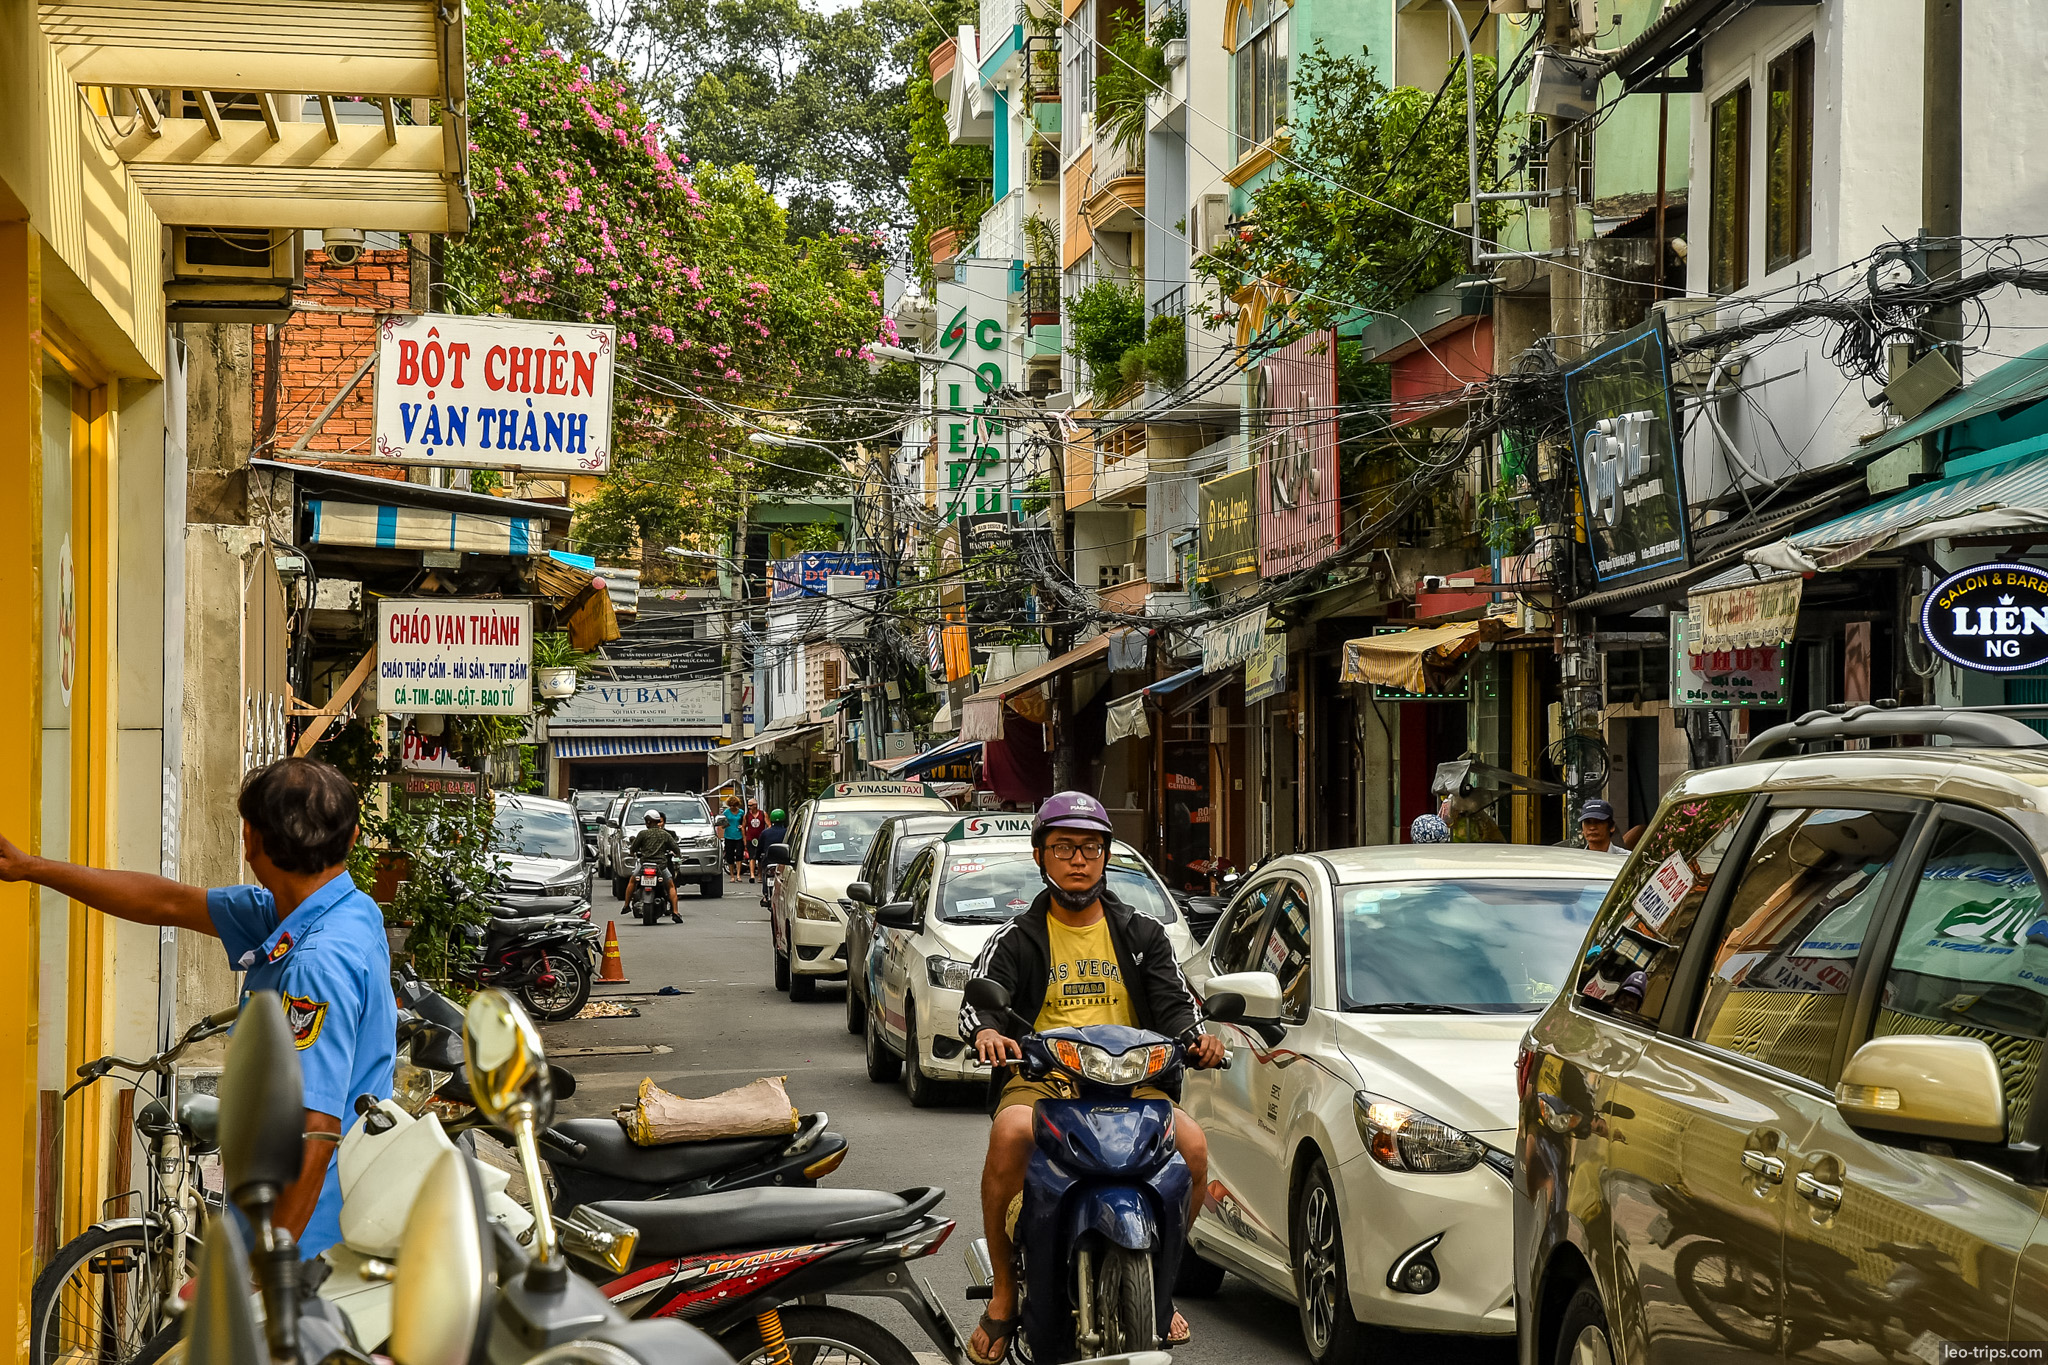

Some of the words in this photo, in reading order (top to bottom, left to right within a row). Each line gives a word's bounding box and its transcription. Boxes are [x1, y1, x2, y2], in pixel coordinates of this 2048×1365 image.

[397, 326, 470, 400] BỘT
[484, 334, 598, 398] CHIÊN
[400, 402, 470, 456] VẠN
[477, 398, 588, 454] THÀNH
[1939, 575, 1988, 610] SALON
[1992, 572, 2002, 586] &
[2006, 572, 2048, 597] BARB
[390, 608, 431, 645] CHÁO
[435, 614, 465, 651] VẠN
[470, 608, 520, 646] THÀNH
[1986, 640, 2020, 658] NG
[382, 658, 403, 679] CHÁO
[405, 658, 427, 682] THẬP
[453, 656, 467, 679] HẢI
[468, 657, 485, 680] SẢN
[394, 684, 406, 705] CÁ
[412, 688, 429, 706] TIM
[434, 688, 453, 706] GAN
[458, 685, 476, 709] CẬT
[481, 689, 499, 706] BAO
[601, 688, 629, 707] VỤ
[1175, 773, 1195, 786] ROG
[857, 785, 901, 794] VINASUN
[902, 785, 922, 794] TAXI
[1198, 806, 1210, 817] RO
[995, 819, 1032, 831] VINA
[1076, 959, 1122, 983] VEGA
[1064, 983, 1105, 994] NEVADA
[1058, 997, 1110, 1006] TRADEMARK
